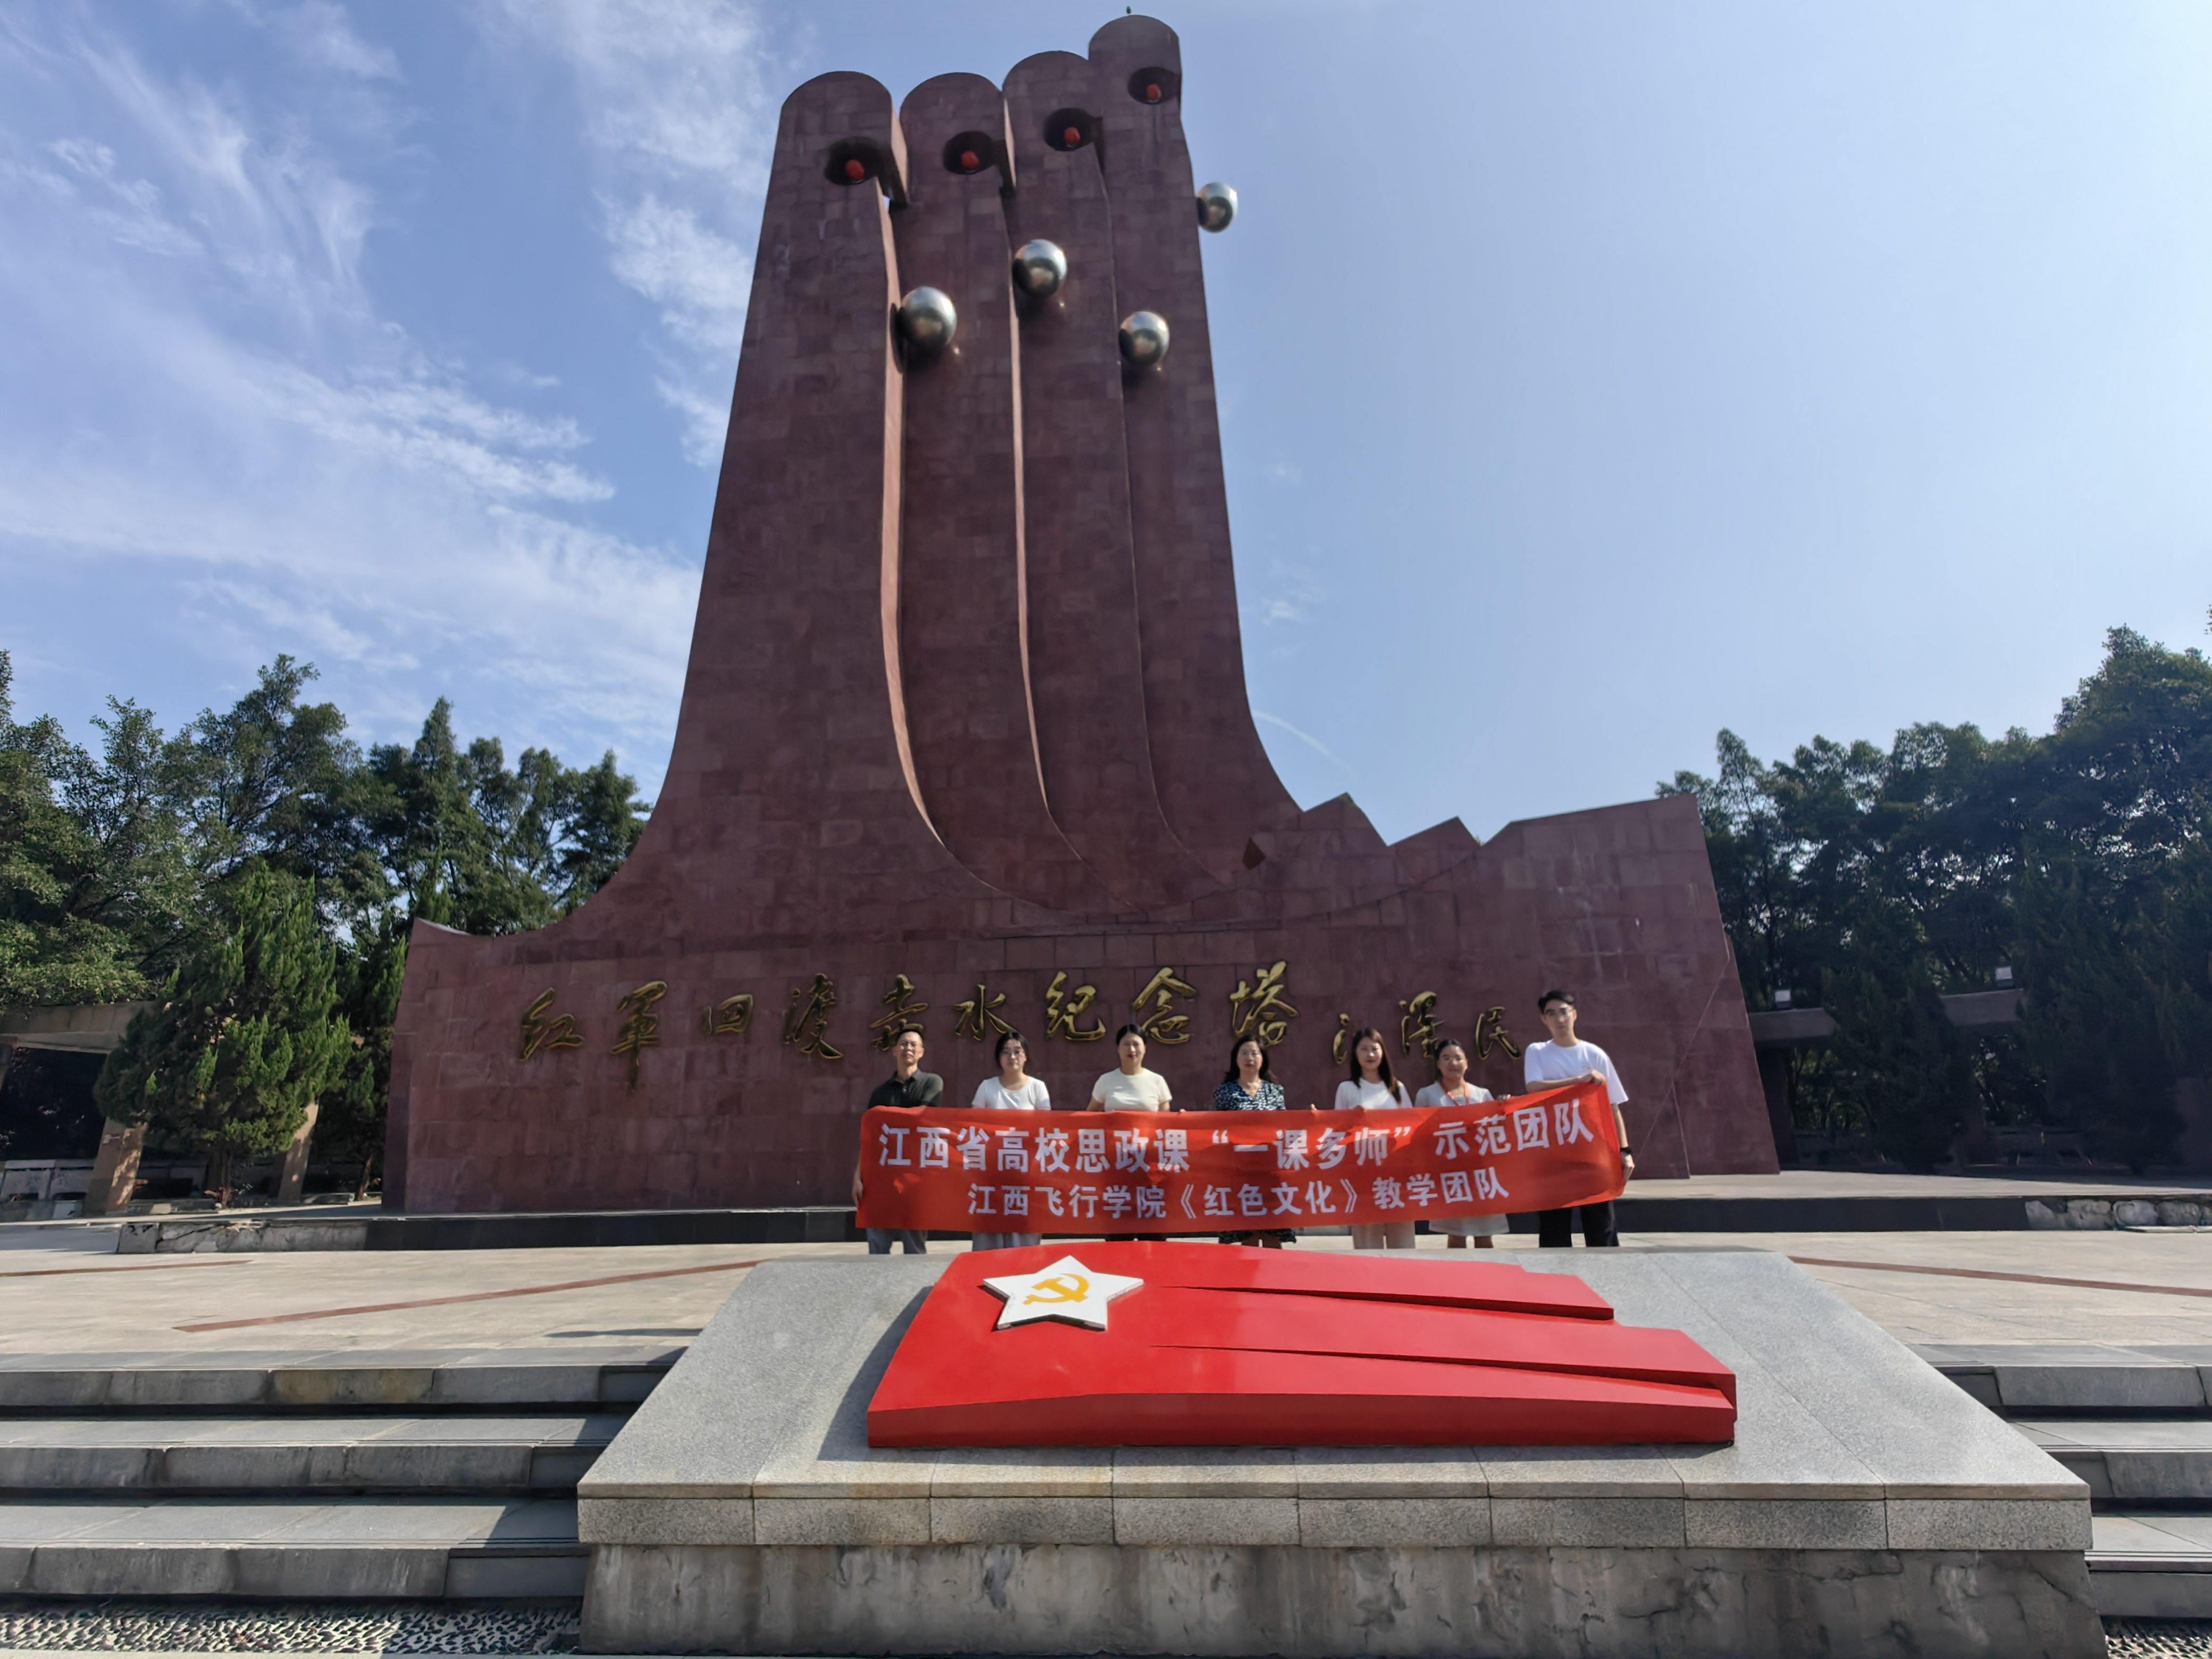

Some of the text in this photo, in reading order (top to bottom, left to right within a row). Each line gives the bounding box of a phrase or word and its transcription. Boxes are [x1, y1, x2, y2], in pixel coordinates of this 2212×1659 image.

[967, 1167, 1510, 1219] 江西飞行学院《红色文化》教学团队
